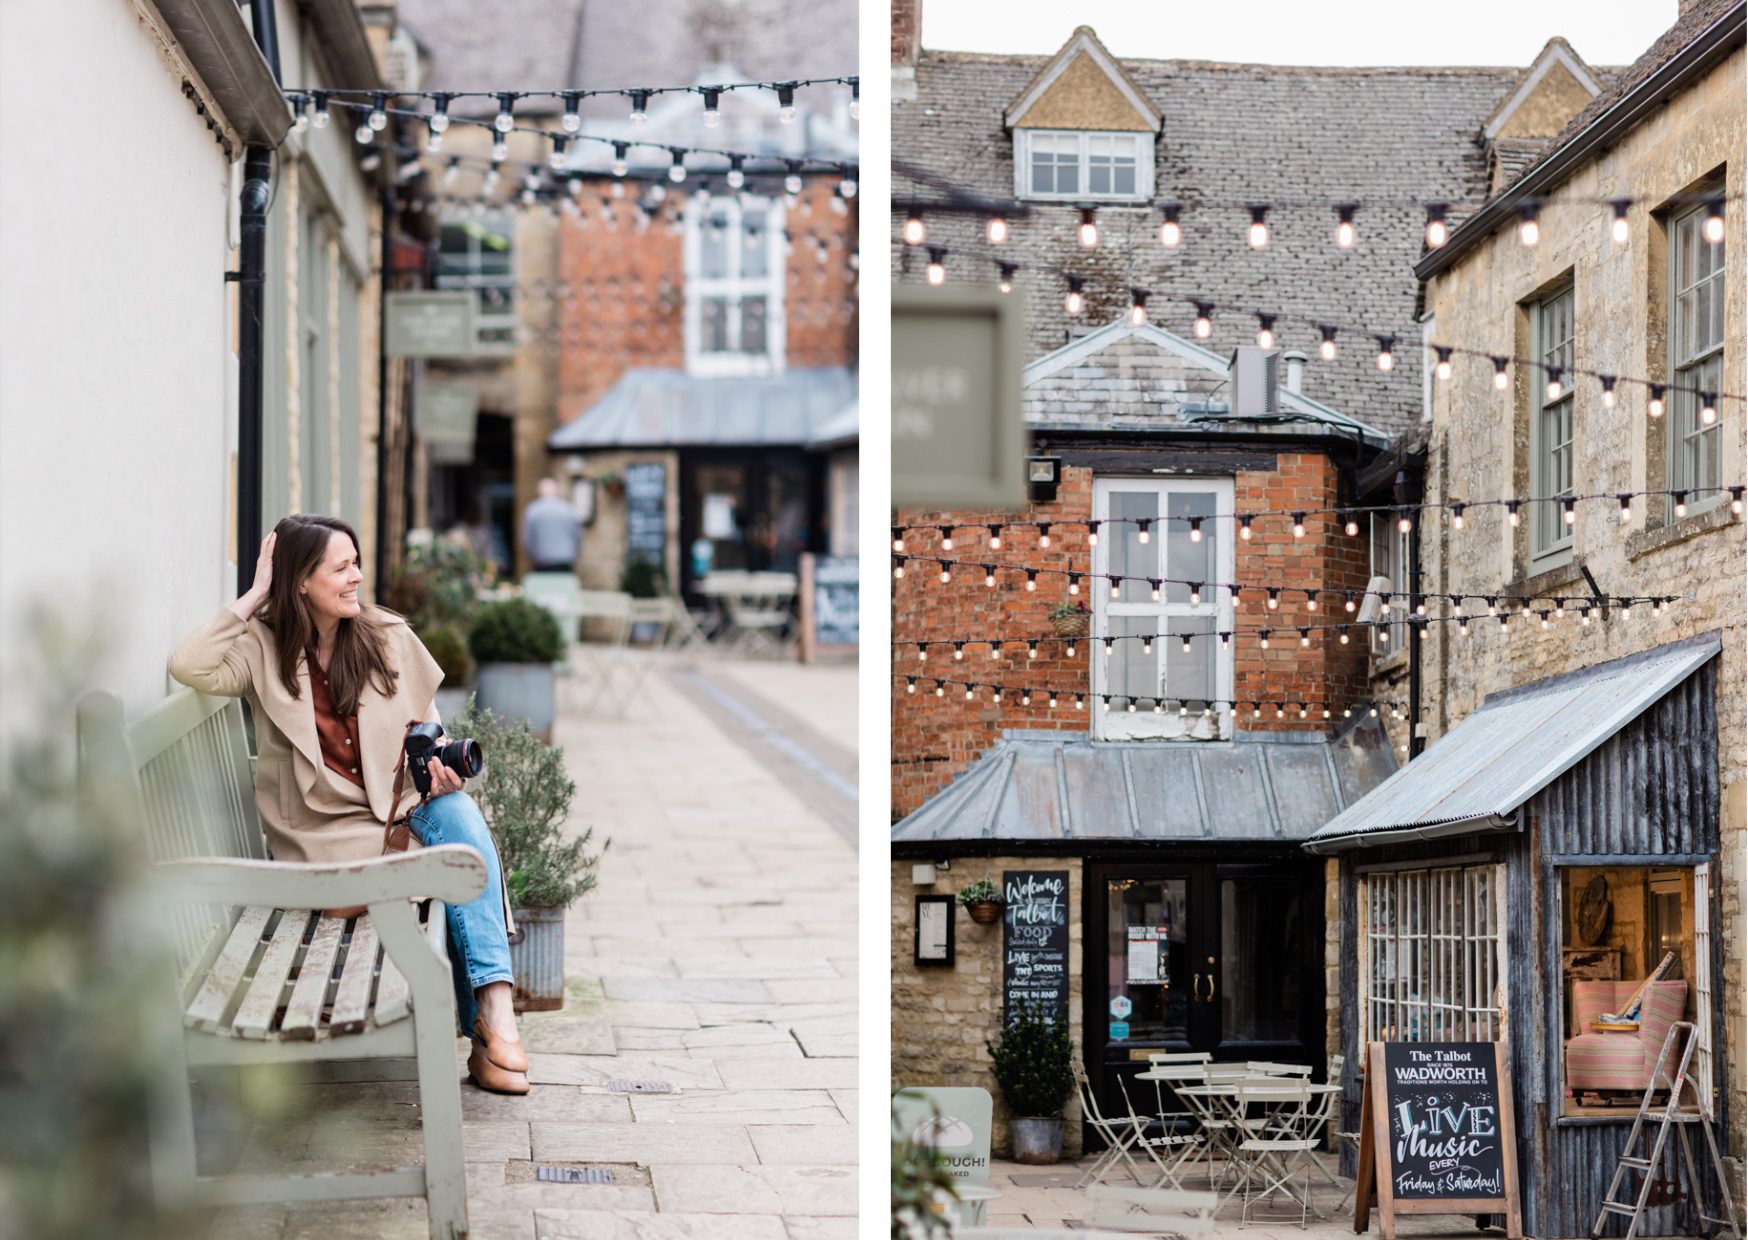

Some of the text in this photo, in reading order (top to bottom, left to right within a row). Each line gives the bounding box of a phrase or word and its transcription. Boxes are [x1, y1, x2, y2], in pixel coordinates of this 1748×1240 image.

[1006, 874, 1065, 903] Welcome
[1006, 896, 1066, 926] Talbot
[1014, 927, 1053, 938] FOOD
[1007, 950, 1030, 964] LIVE
[1033, 964, 1063, 973] SPORTS
[1409, 1050, 1471, 1062] The Talbot
[1395, 1067, 1486, 1080] WADWORTH
[1397, 1124, 1493, 1163] Music
[1429, 1157, 1460, 1171] EVERY
[1396, 1170, 1435, 1195] Friday
